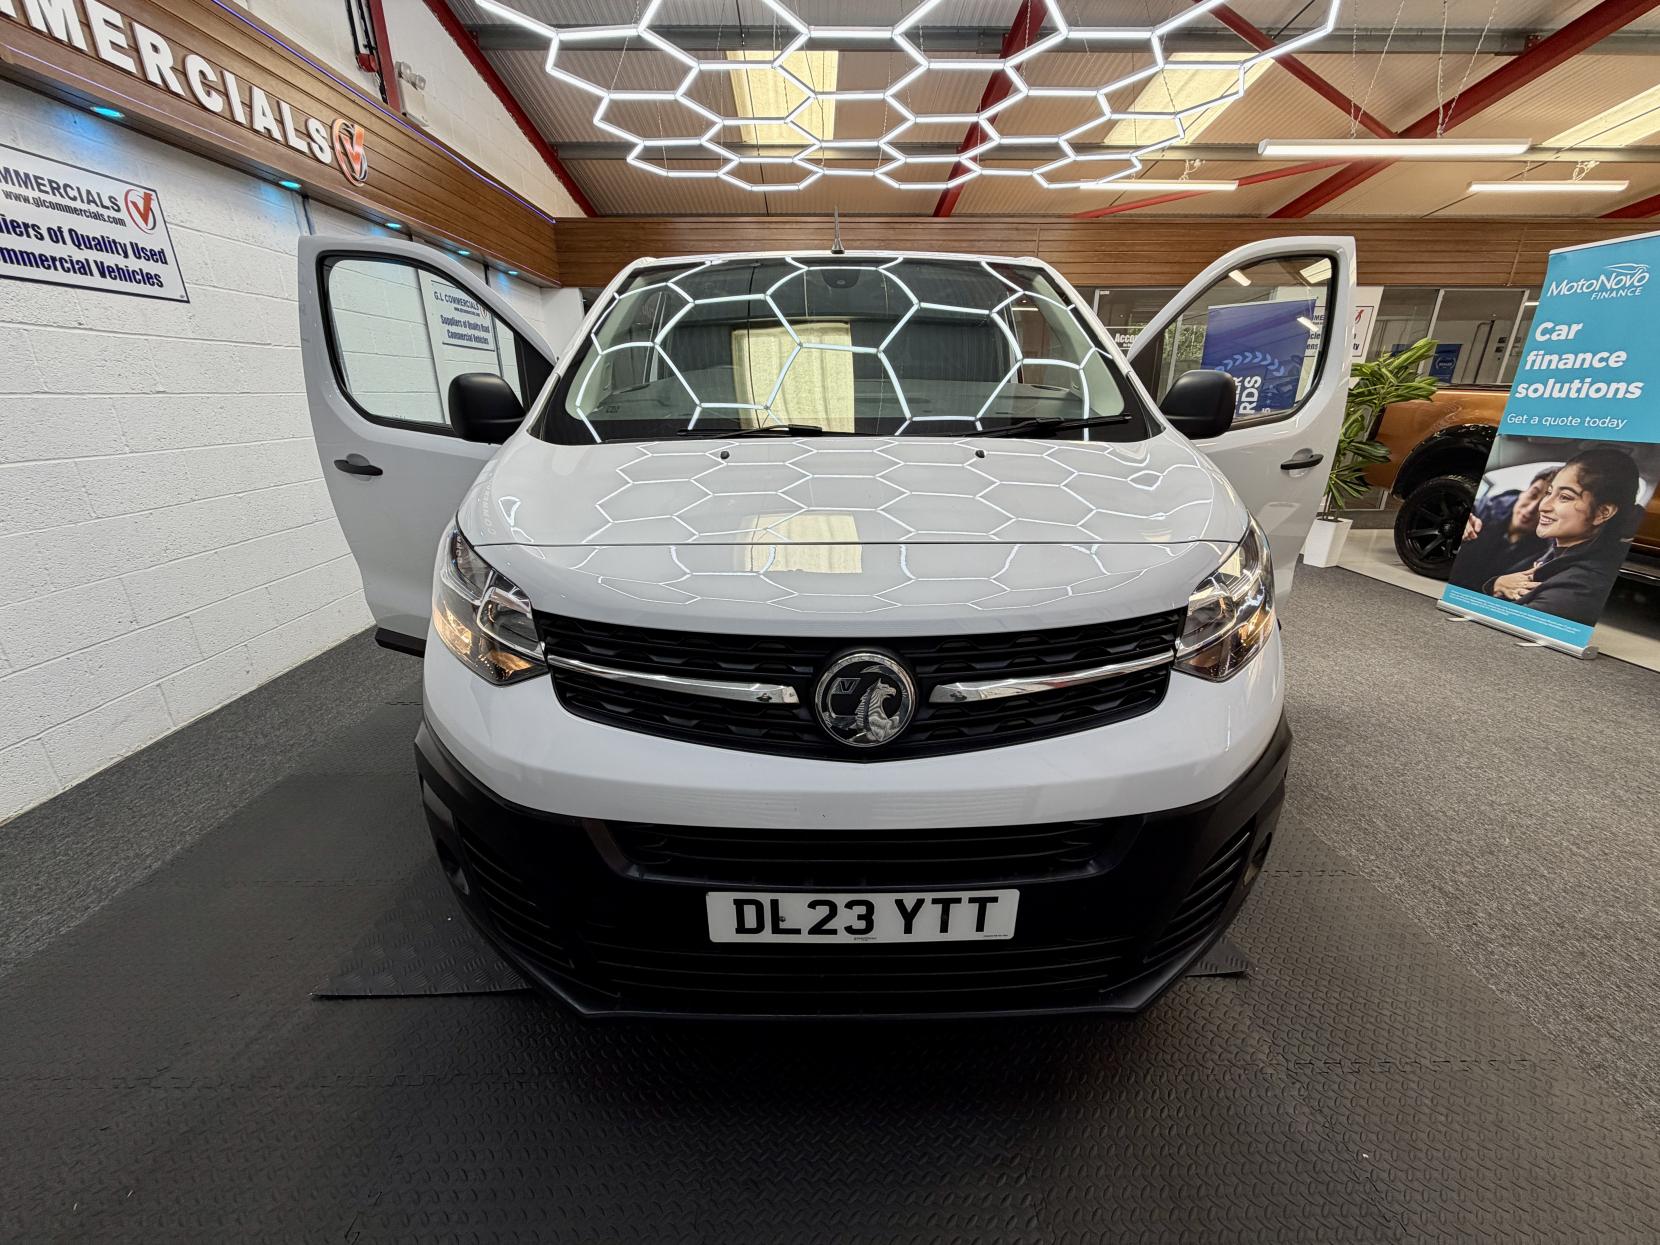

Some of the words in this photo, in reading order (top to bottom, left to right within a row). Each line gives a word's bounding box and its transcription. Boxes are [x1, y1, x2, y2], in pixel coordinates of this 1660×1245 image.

[1, 189, 127, 228] www.glcommercials.com
[49, 225, 67, 245] of
[67, 228, 130, 259] Quality
[129, 241, 169, 265] Used
[93, 258, 164, 288] Vehicles
[1547, 266, 1650, 297] MotoNovo
[1591, 287, 1643, 300] FINANCE
[1535, 321, 1584, 342] Car
[1525, 350, 1628, 370] finance
[1515, 377, 1645, 399] solutions
[1507, 413, 1528, 424] Get
[1530, 415, 1539, 425] a
[1542, 415, 1581, 427] quote
[1584, 416, 1628, 430] today
[732, 897, 875, 936] DL23
[894, 896, 999, 935] YTT
